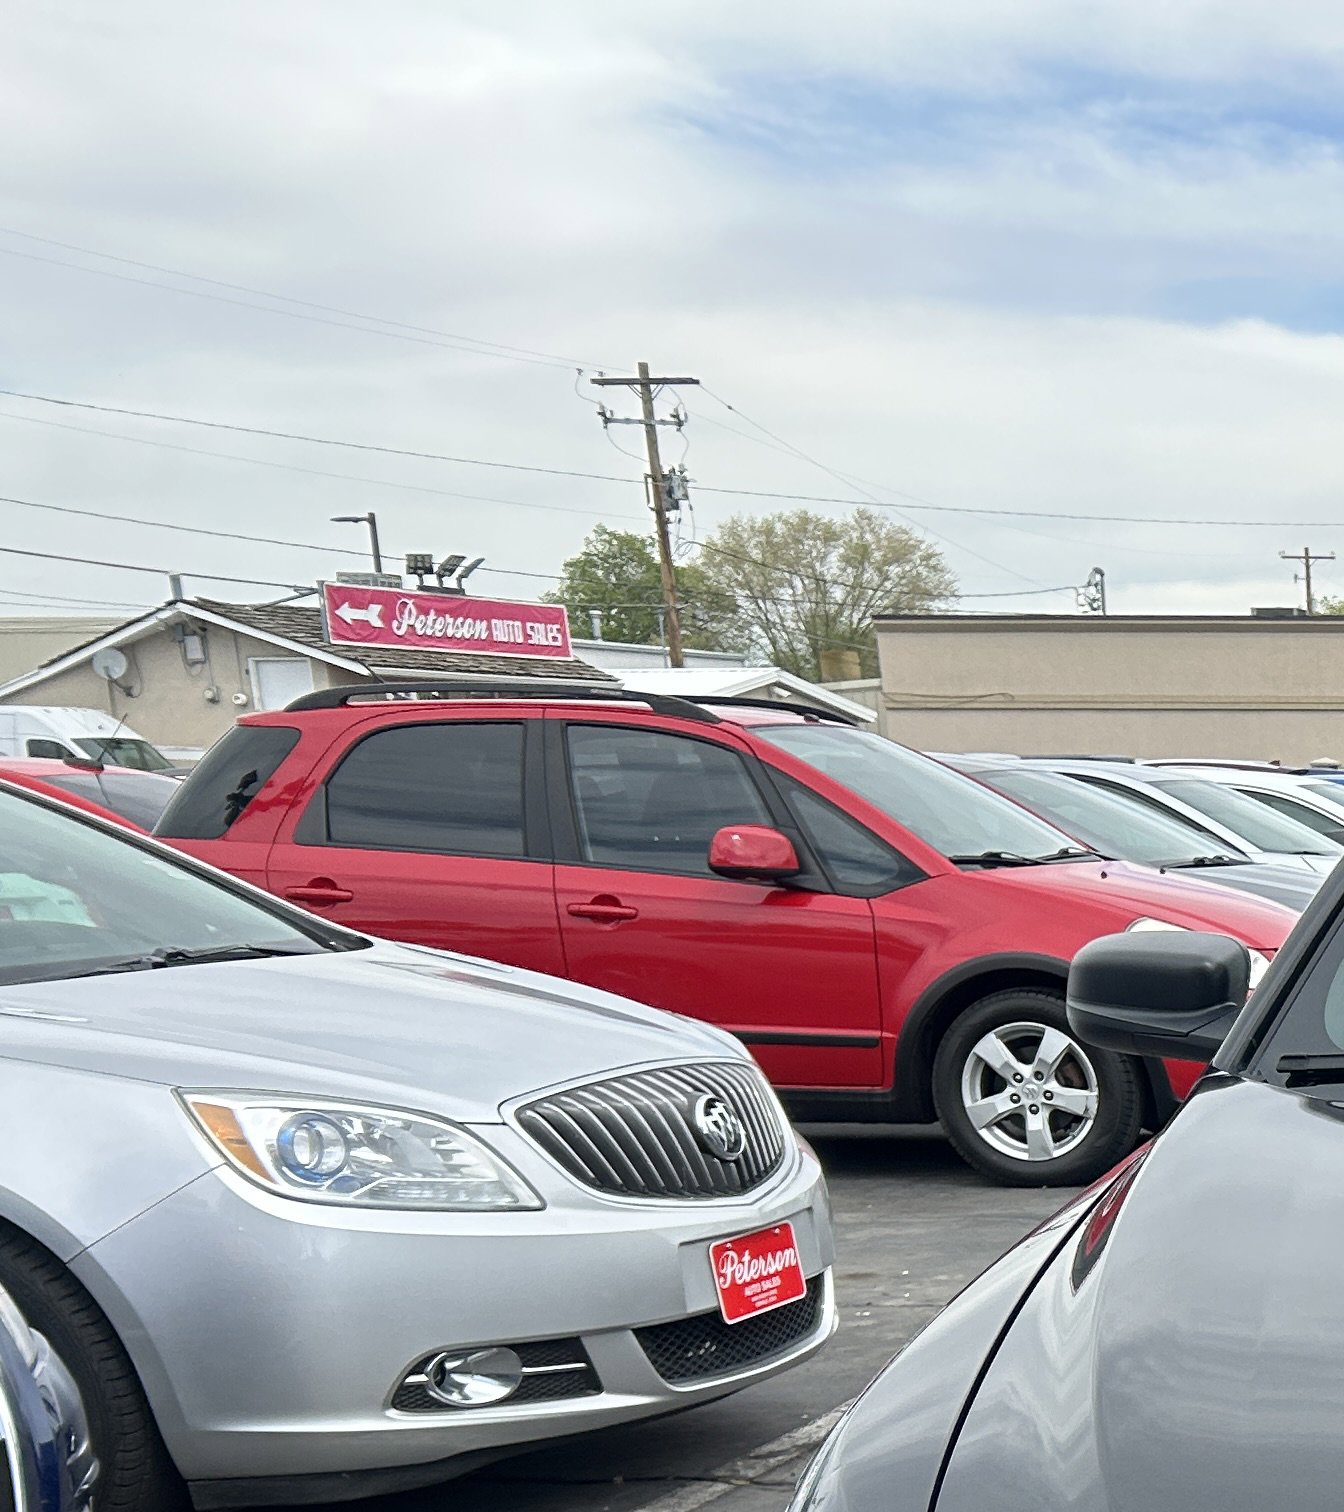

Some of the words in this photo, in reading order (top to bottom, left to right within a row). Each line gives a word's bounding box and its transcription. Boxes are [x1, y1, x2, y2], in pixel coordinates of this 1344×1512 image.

[391, 598, 489, 640] Peterson
[491, 618, 524, 643] AUTO
[526, 622, 562, 646] SALES
[719, 1247, 797, 1289] Peterson
